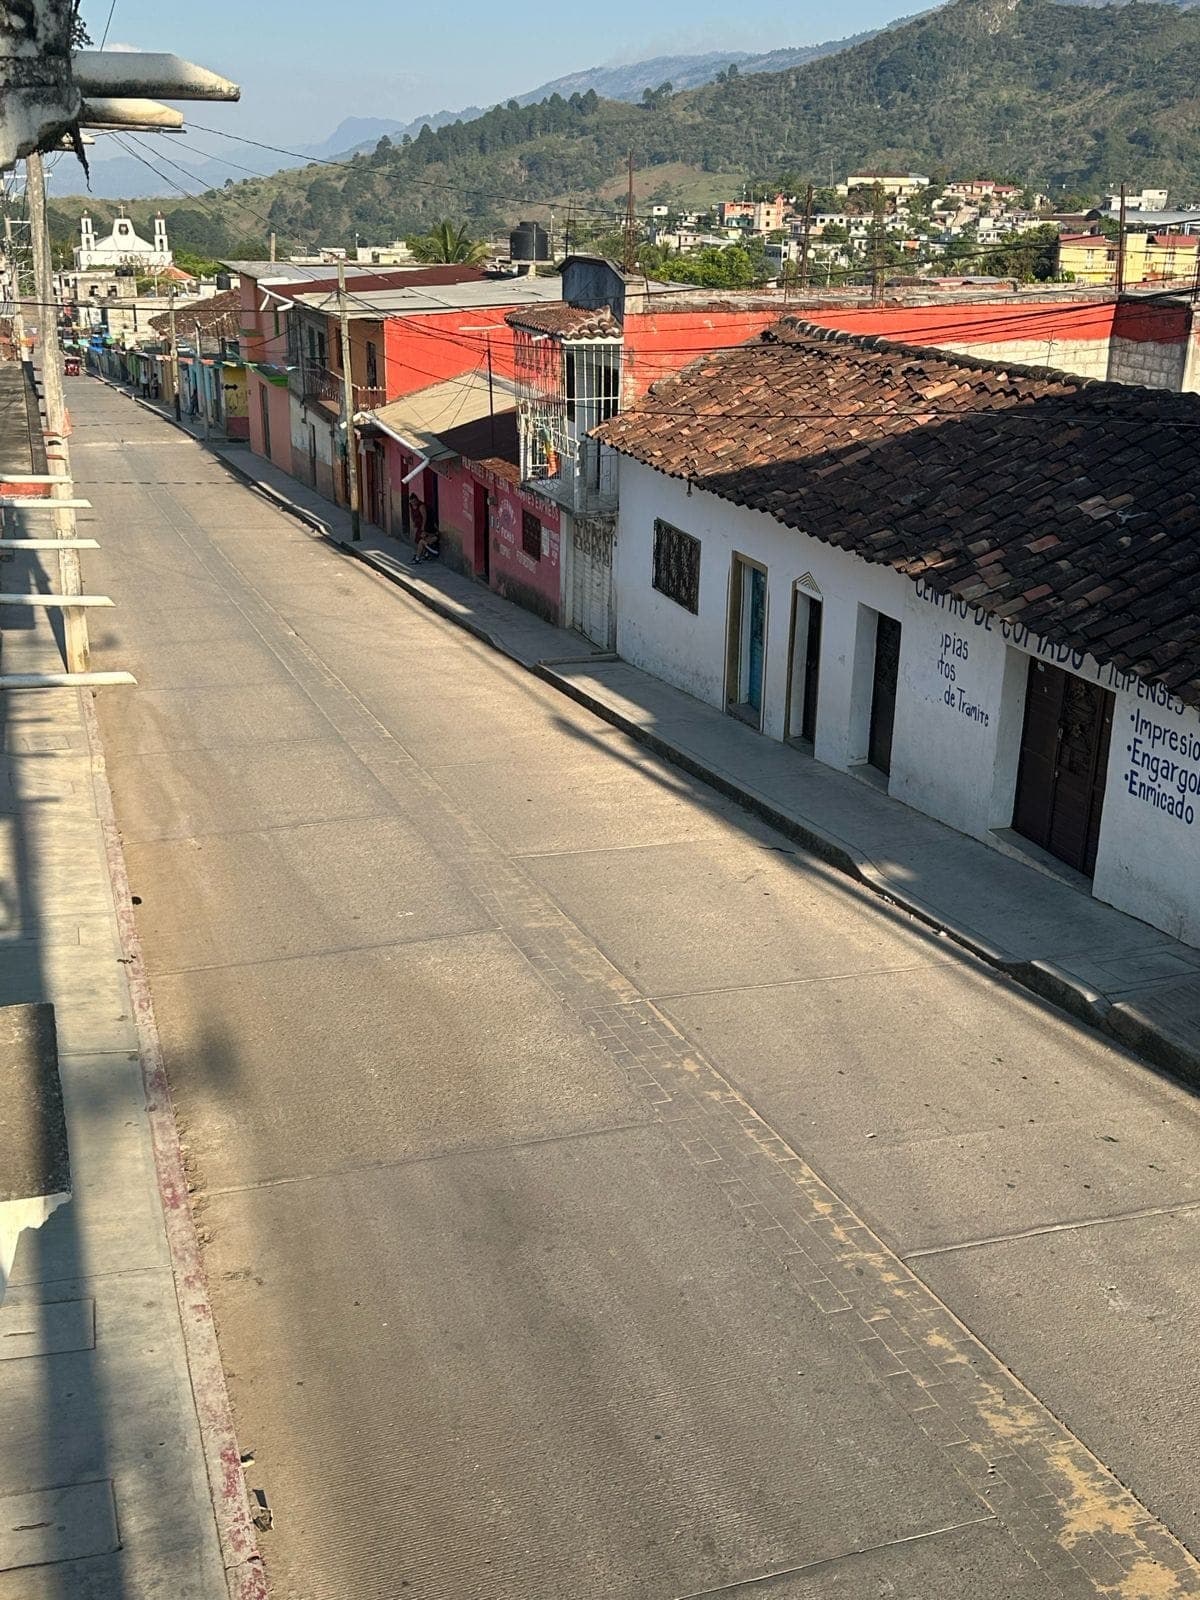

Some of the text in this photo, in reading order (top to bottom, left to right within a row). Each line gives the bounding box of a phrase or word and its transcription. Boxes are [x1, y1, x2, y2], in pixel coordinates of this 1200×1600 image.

[974, 605, 995, 631] DE
[943, 684, 956, 708] de
[1128, 769, 1194, 824] Enmicado
